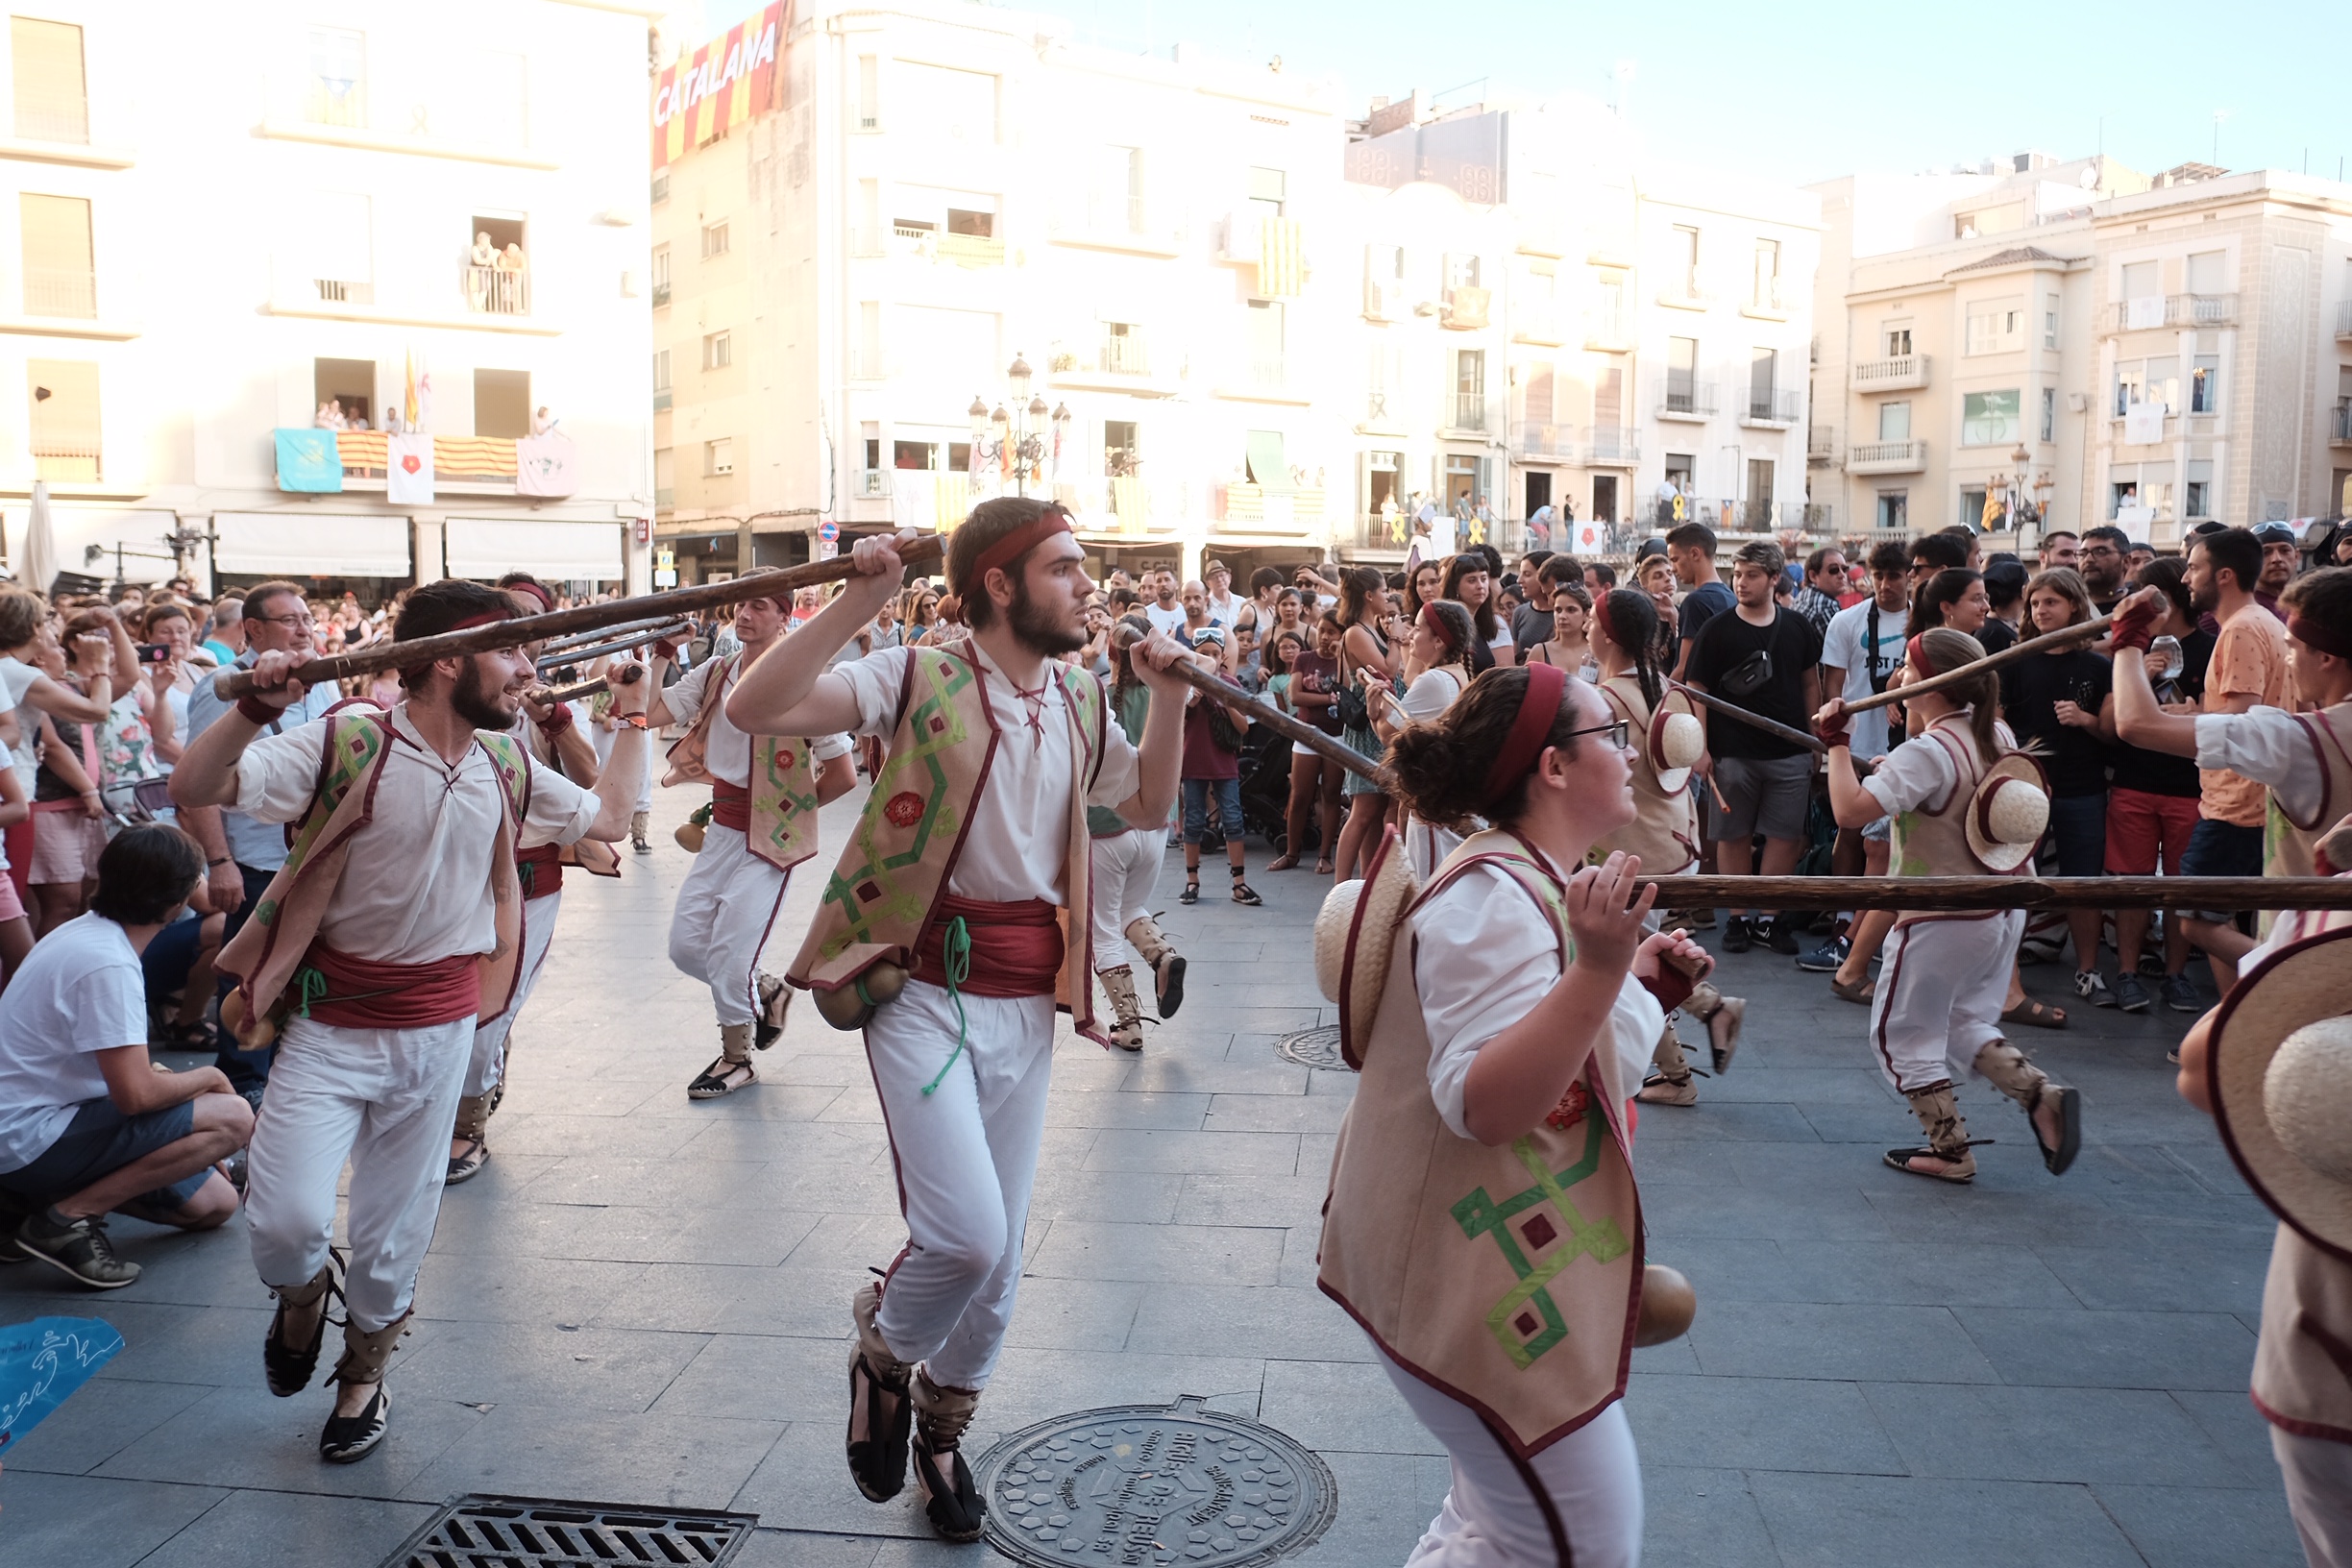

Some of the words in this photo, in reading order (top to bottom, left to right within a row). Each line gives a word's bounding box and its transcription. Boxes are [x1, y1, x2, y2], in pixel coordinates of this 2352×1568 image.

[654, 22, 776, 127] CATALANA
[1864, 657, 1889, 668] JST
[1160, 1431, 1197, 1479] AIGÜES
[1144, 1484, 1174, 1507] DE
[1187, 1465, 1235, 1526] SANEJAMENT
